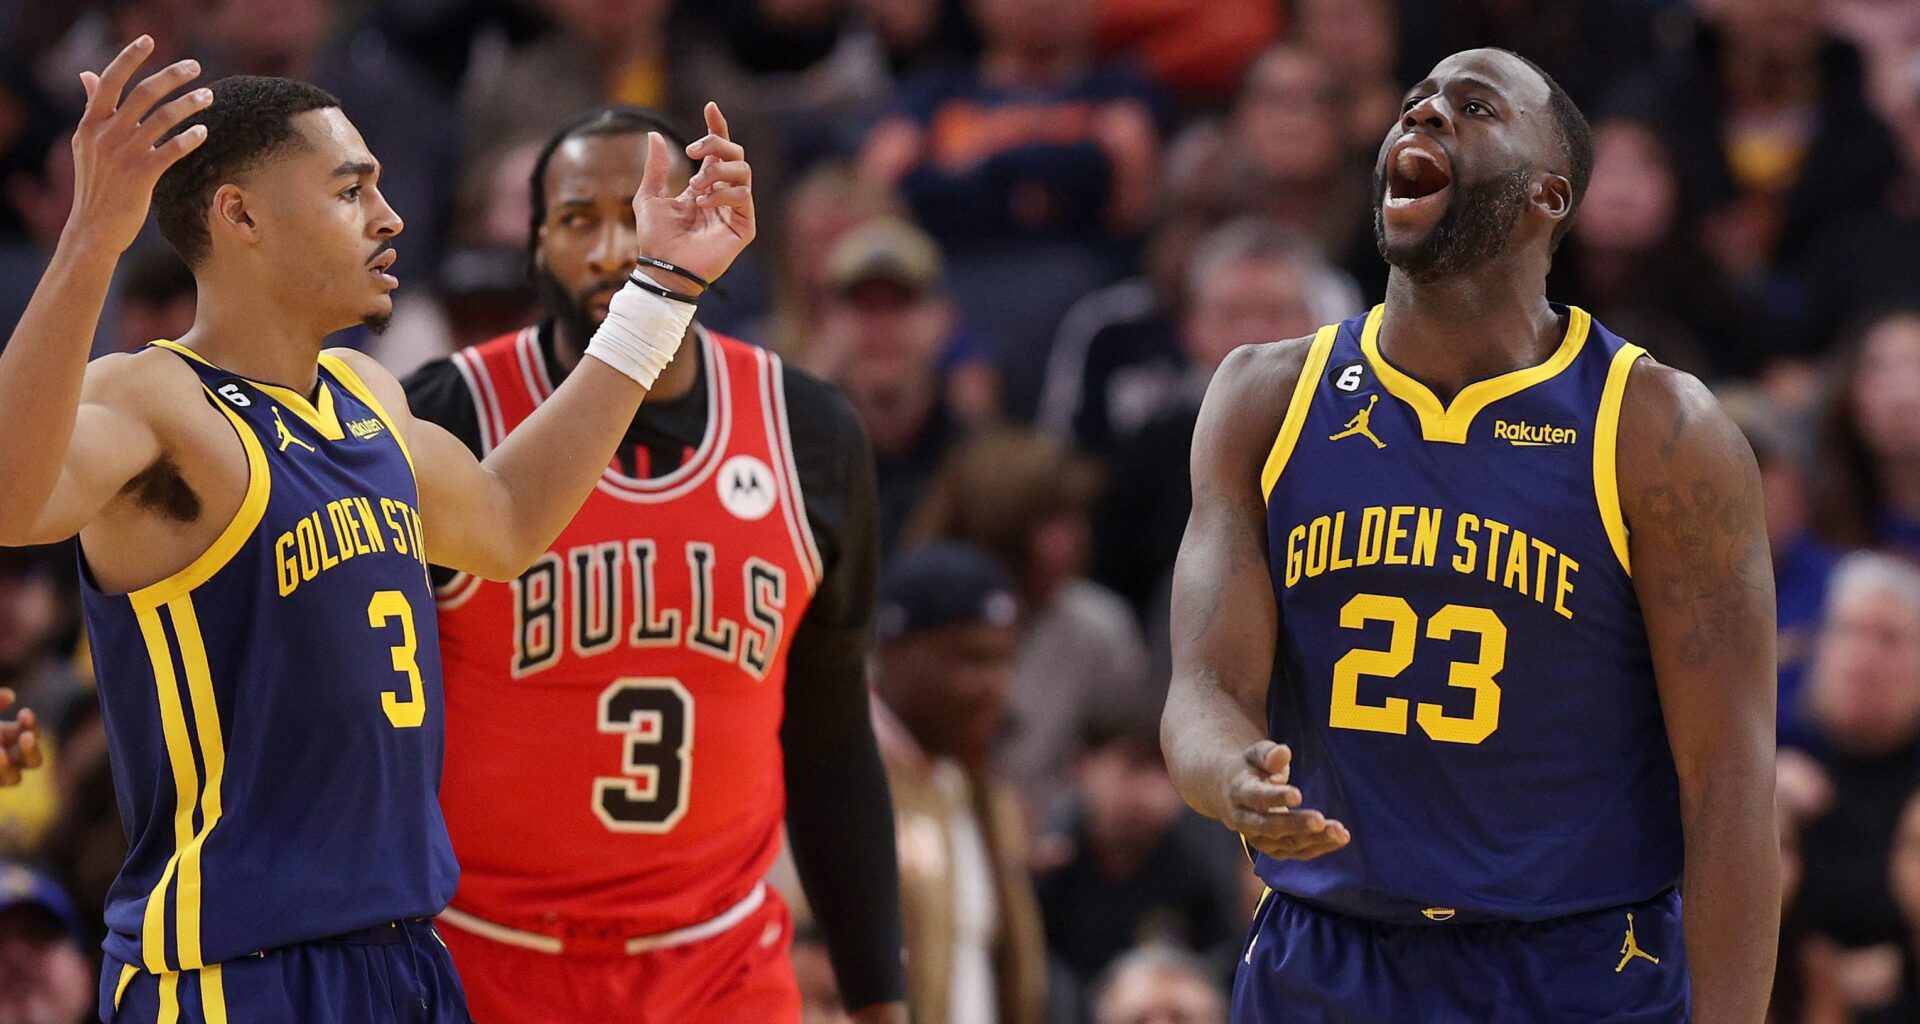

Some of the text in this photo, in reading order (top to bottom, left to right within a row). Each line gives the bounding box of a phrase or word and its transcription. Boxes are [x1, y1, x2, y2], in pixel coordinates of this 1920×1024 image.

[218, 383, 251, 407] 6
[346, 418, 384, 438] Rakuten
[1335, 364, 1363, 392] 6
[1494, 420, 1577, 444] Rakuten
[275, 497, 431, 598] GOLDEN STA
[1284, 505, 1580, 620] GOLDEN STATE
[367, 590, 426, 728] 3
[511, 538, 787, 682] BULLS
[1329, 592, 1508, 744] 23
[591, 677, 695, 834] 3
